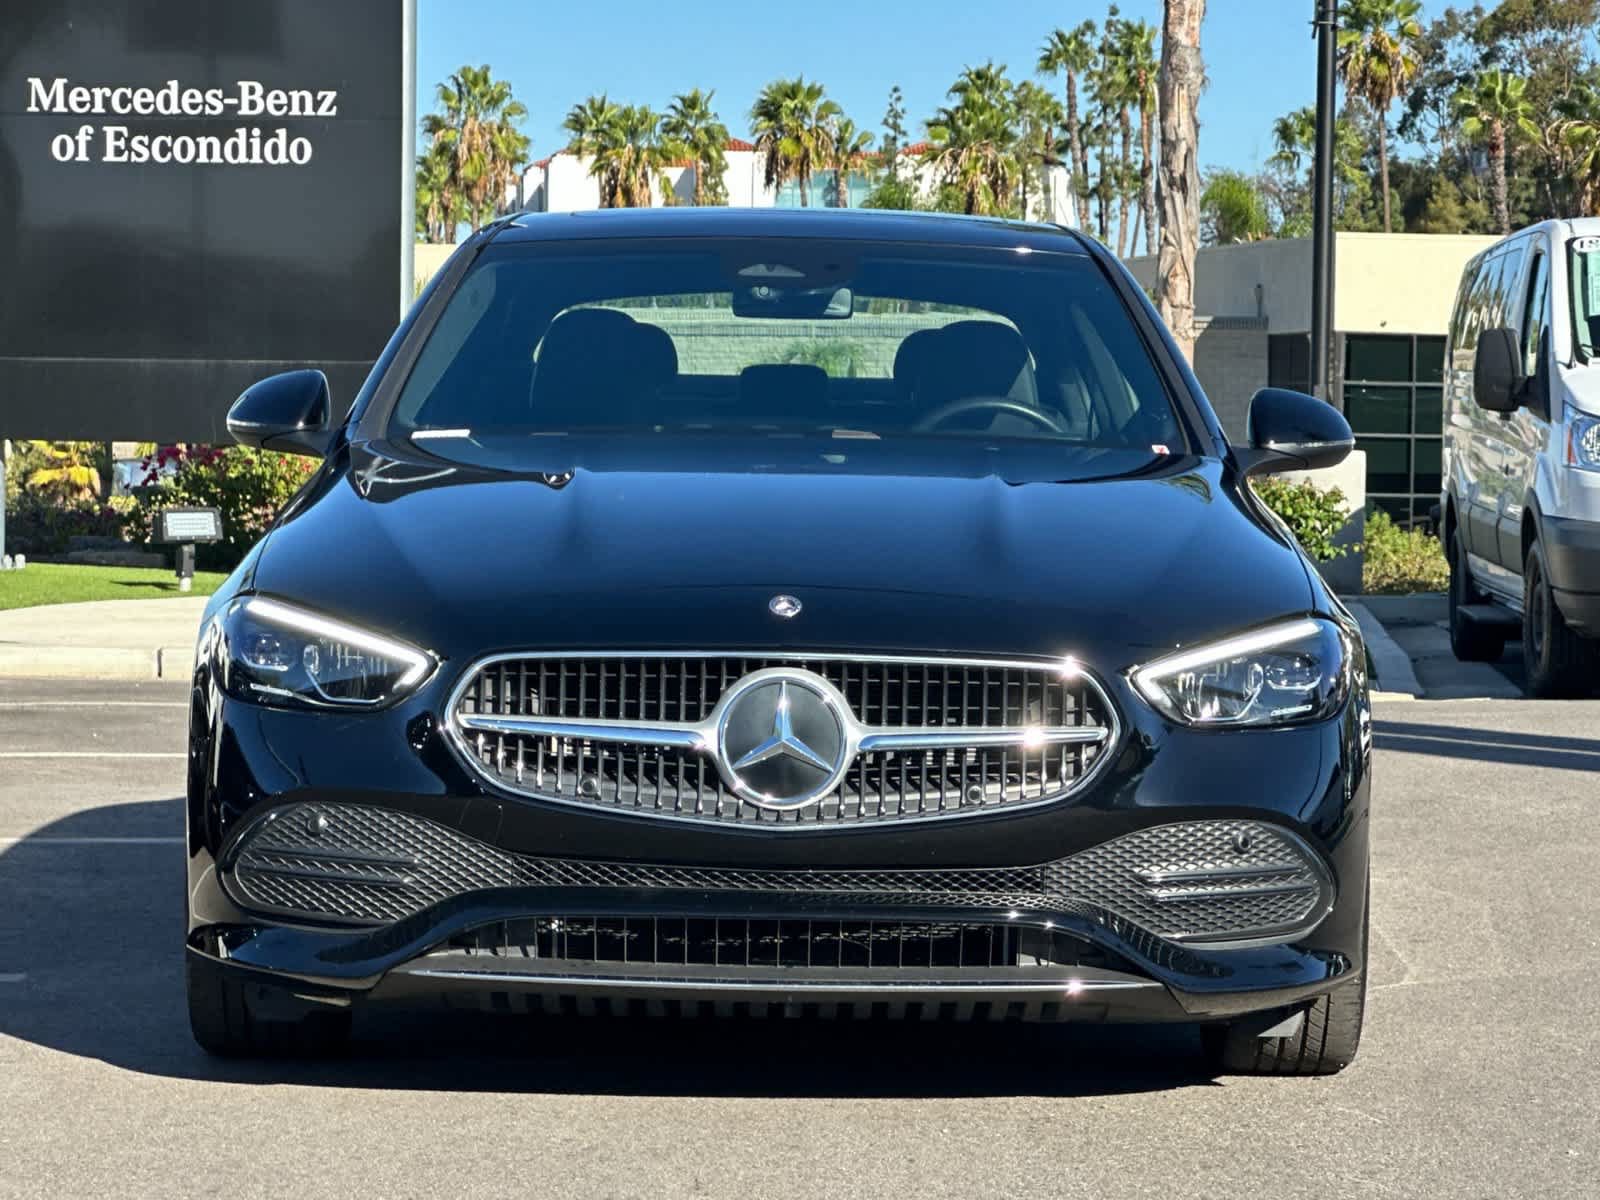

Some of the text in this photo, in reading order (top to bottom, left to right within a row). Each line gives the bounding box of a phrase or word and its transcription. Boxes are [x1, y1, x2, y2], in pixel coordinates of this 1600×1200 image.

[26, 77, 338, 117] Mercedes-Benz
[51, 125, 313, 165] of Escondido
